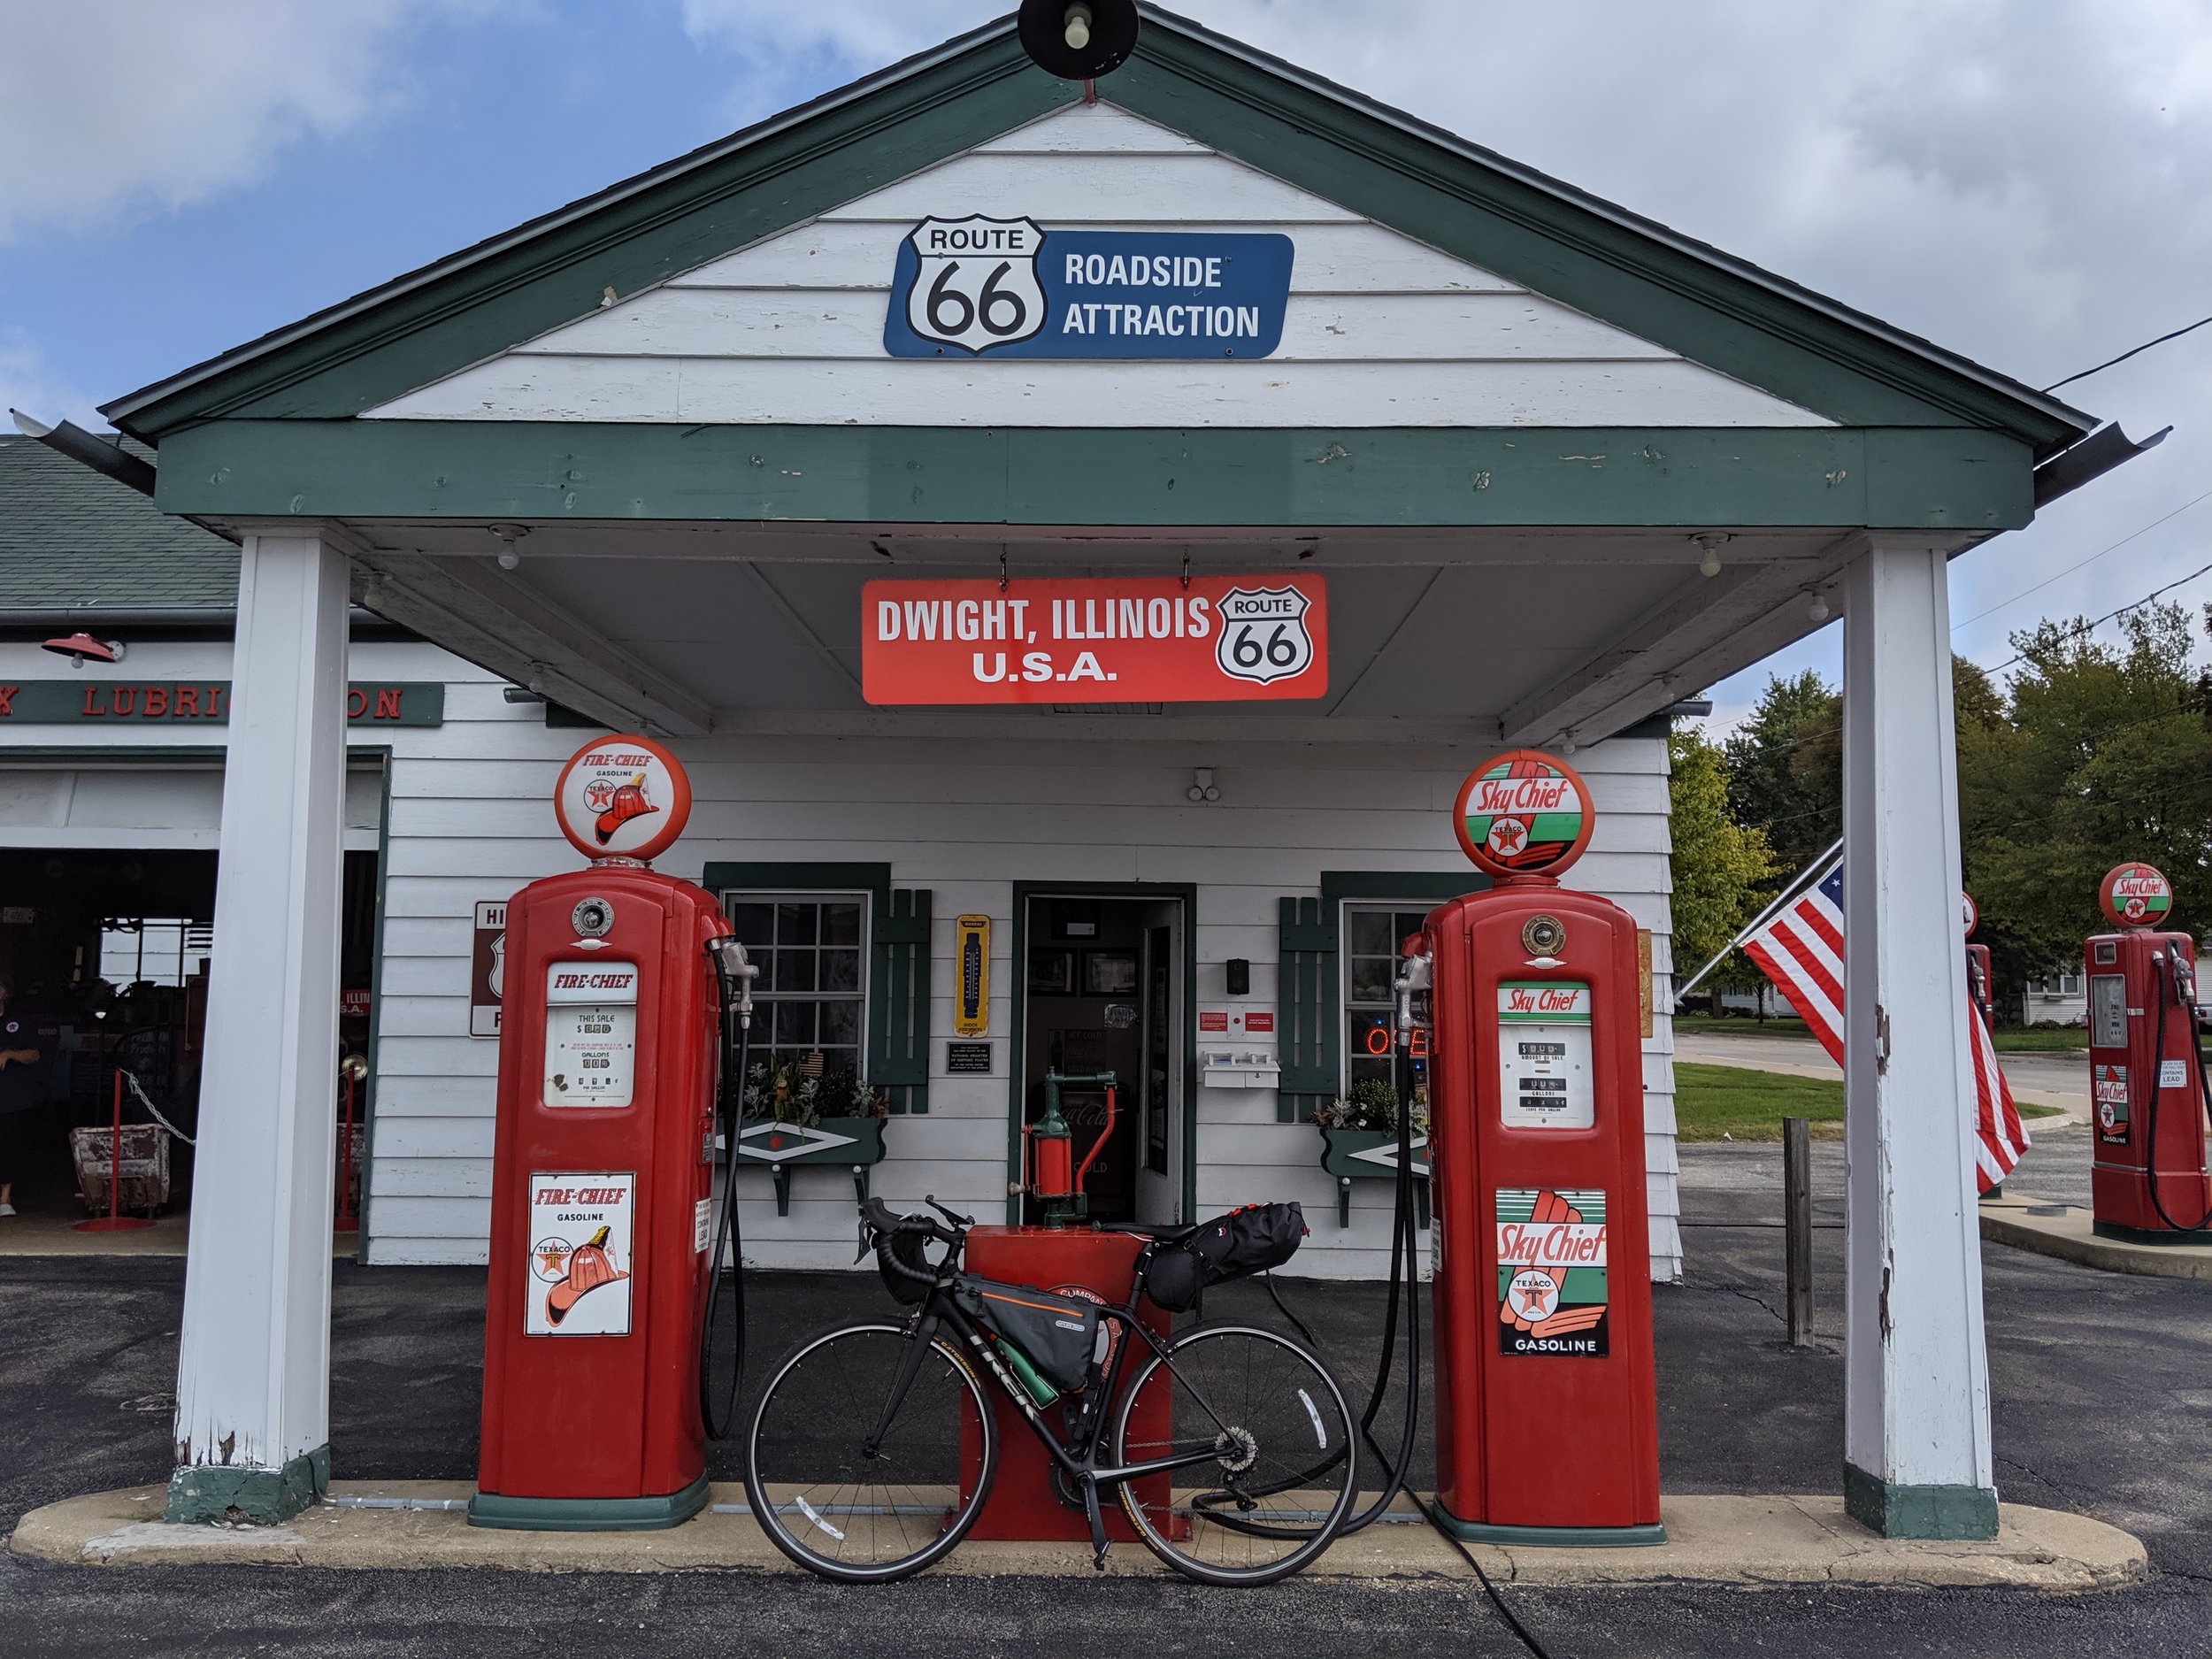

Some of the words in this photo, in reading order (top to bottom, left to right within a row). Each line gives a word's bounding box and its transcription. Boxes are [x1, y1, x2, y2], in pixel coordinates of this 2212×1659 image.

[930, 230, 1024, 250] ROUTE
[1065, 253, 1222, 288] ROADSIDE
[926, 260, 1026, 336] 66
[1063, 303, 1258, 337] ATTRACTION
[1234, 599, 1292, 615] ROUTE
[878, 599, 1037, 644] DWIGHT,
[1052, 596, 1210, 641] ILLINOIS
[1233, 623, 1297, 668] 66
[973, 652, 1118, 682] U.S.A.
[582, 755, 653, 766] FIRE-CHIEF
[1477, 781, 1515, 813] Sky
[1515, 779, 1568, 809] Chief
[2119, 879, 2139, 896] Sky
[2139, 878, 2162, 895] Chief
[554, 974, 634, 989] FIRE-CHIEF
[347, 993, 370, 1003] ILLIN
[1508, 988, 1536, 1013] Sky
[1539, 988, 1579, 1011] Chief
[2097, 1081, 2109, 1102] Sky
[2109, 1083, 2127, 1101] Chief
[1073, 1162, 1108, 1174] COLD
[534, 1187, 626, 1205] FIRE-CHIEF
[1497, 1225, 1543, 1265] Sky
[1543, 1225, 1606, 1261] Chief
[1515, 1340, 1596, 1351] GASOLINE
[941, 1341, 976, 1379] GATORSKIN
[970, 1335, 1041, 1421] TREK
